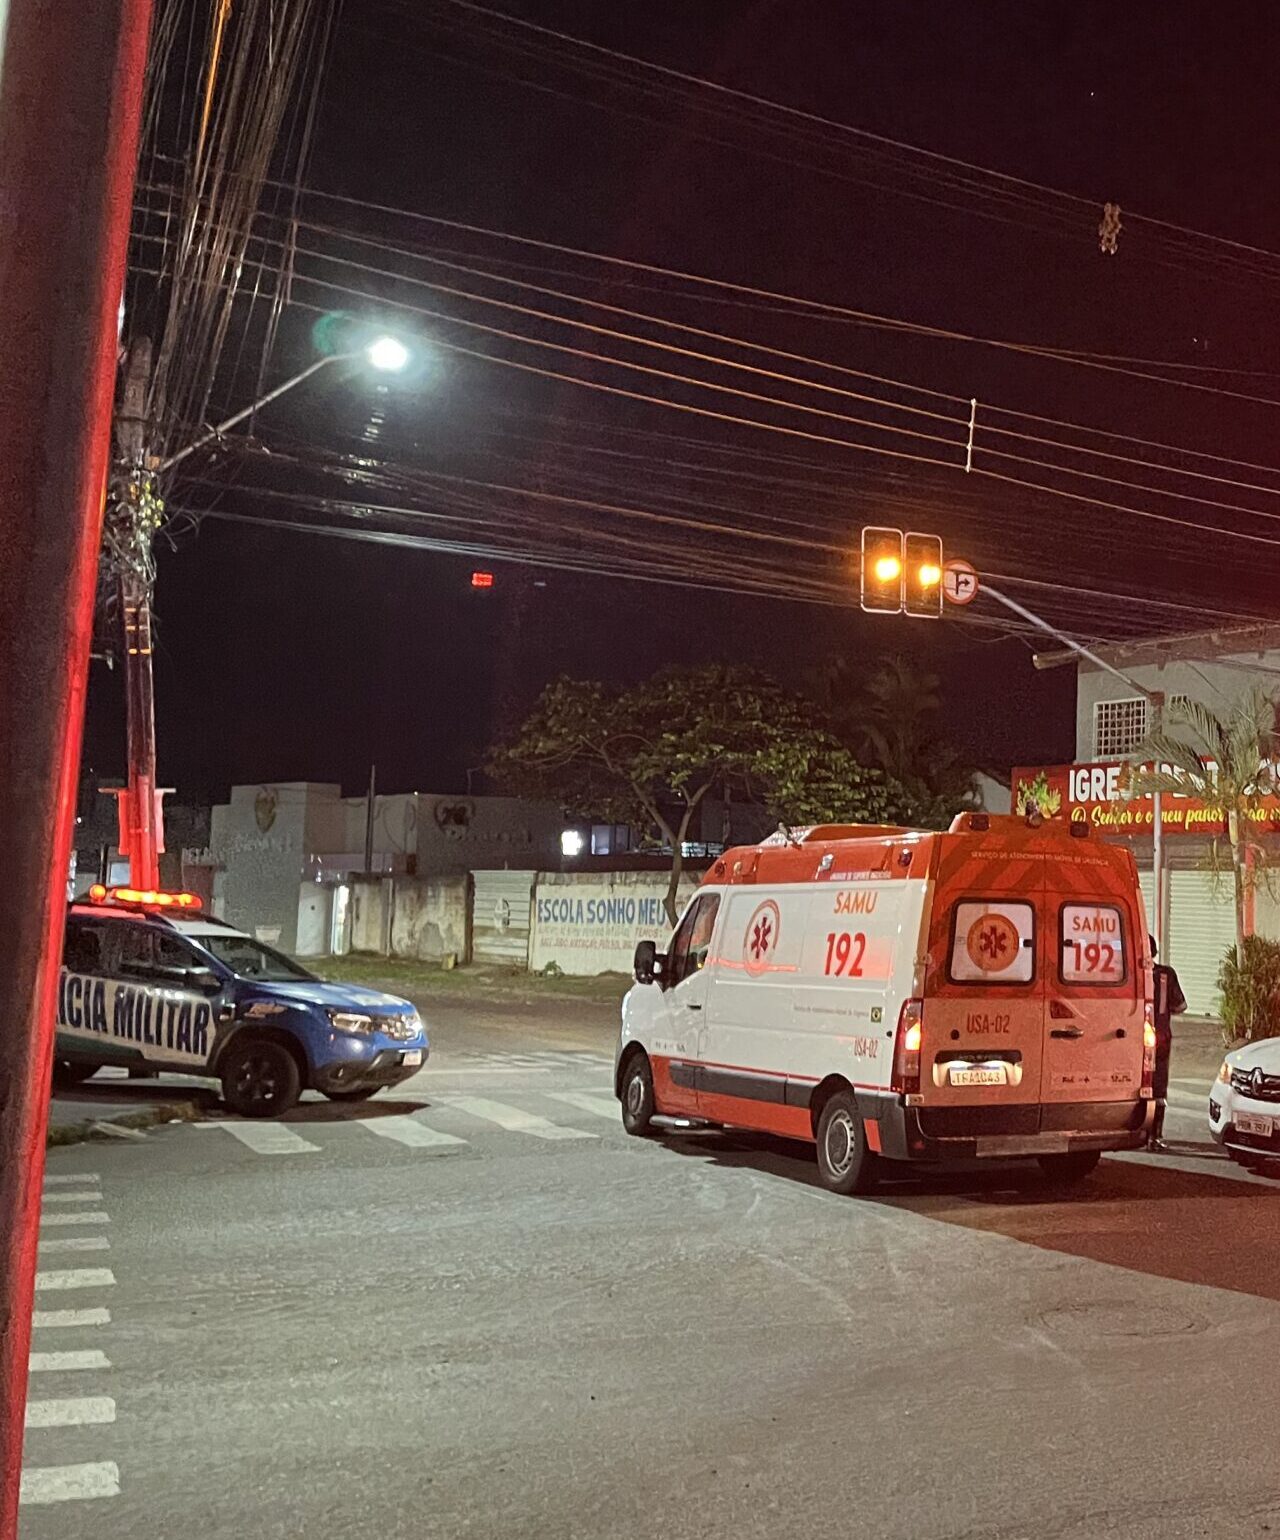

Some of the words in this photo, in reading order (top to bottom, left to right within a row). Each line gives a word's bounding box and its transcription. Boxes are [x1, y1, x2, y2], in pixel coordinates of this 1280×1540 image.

[1068, 763, 1152, 803] IGRE
[537, 898, 583, 925] ESCOLA
[587, 898, 636, 925] SONHO
[639, 898, 666, 926] MEU
[833, 891, 878, 914] SAMU
[1072, 915, 1116, 933] SAMU
[825, 932, 866, 977] 192
[1072, 942, 1116, 974] 192
[114, 984, 210, 1056] MILITAR
[966, 1012, 1011, 1034] USA-02
